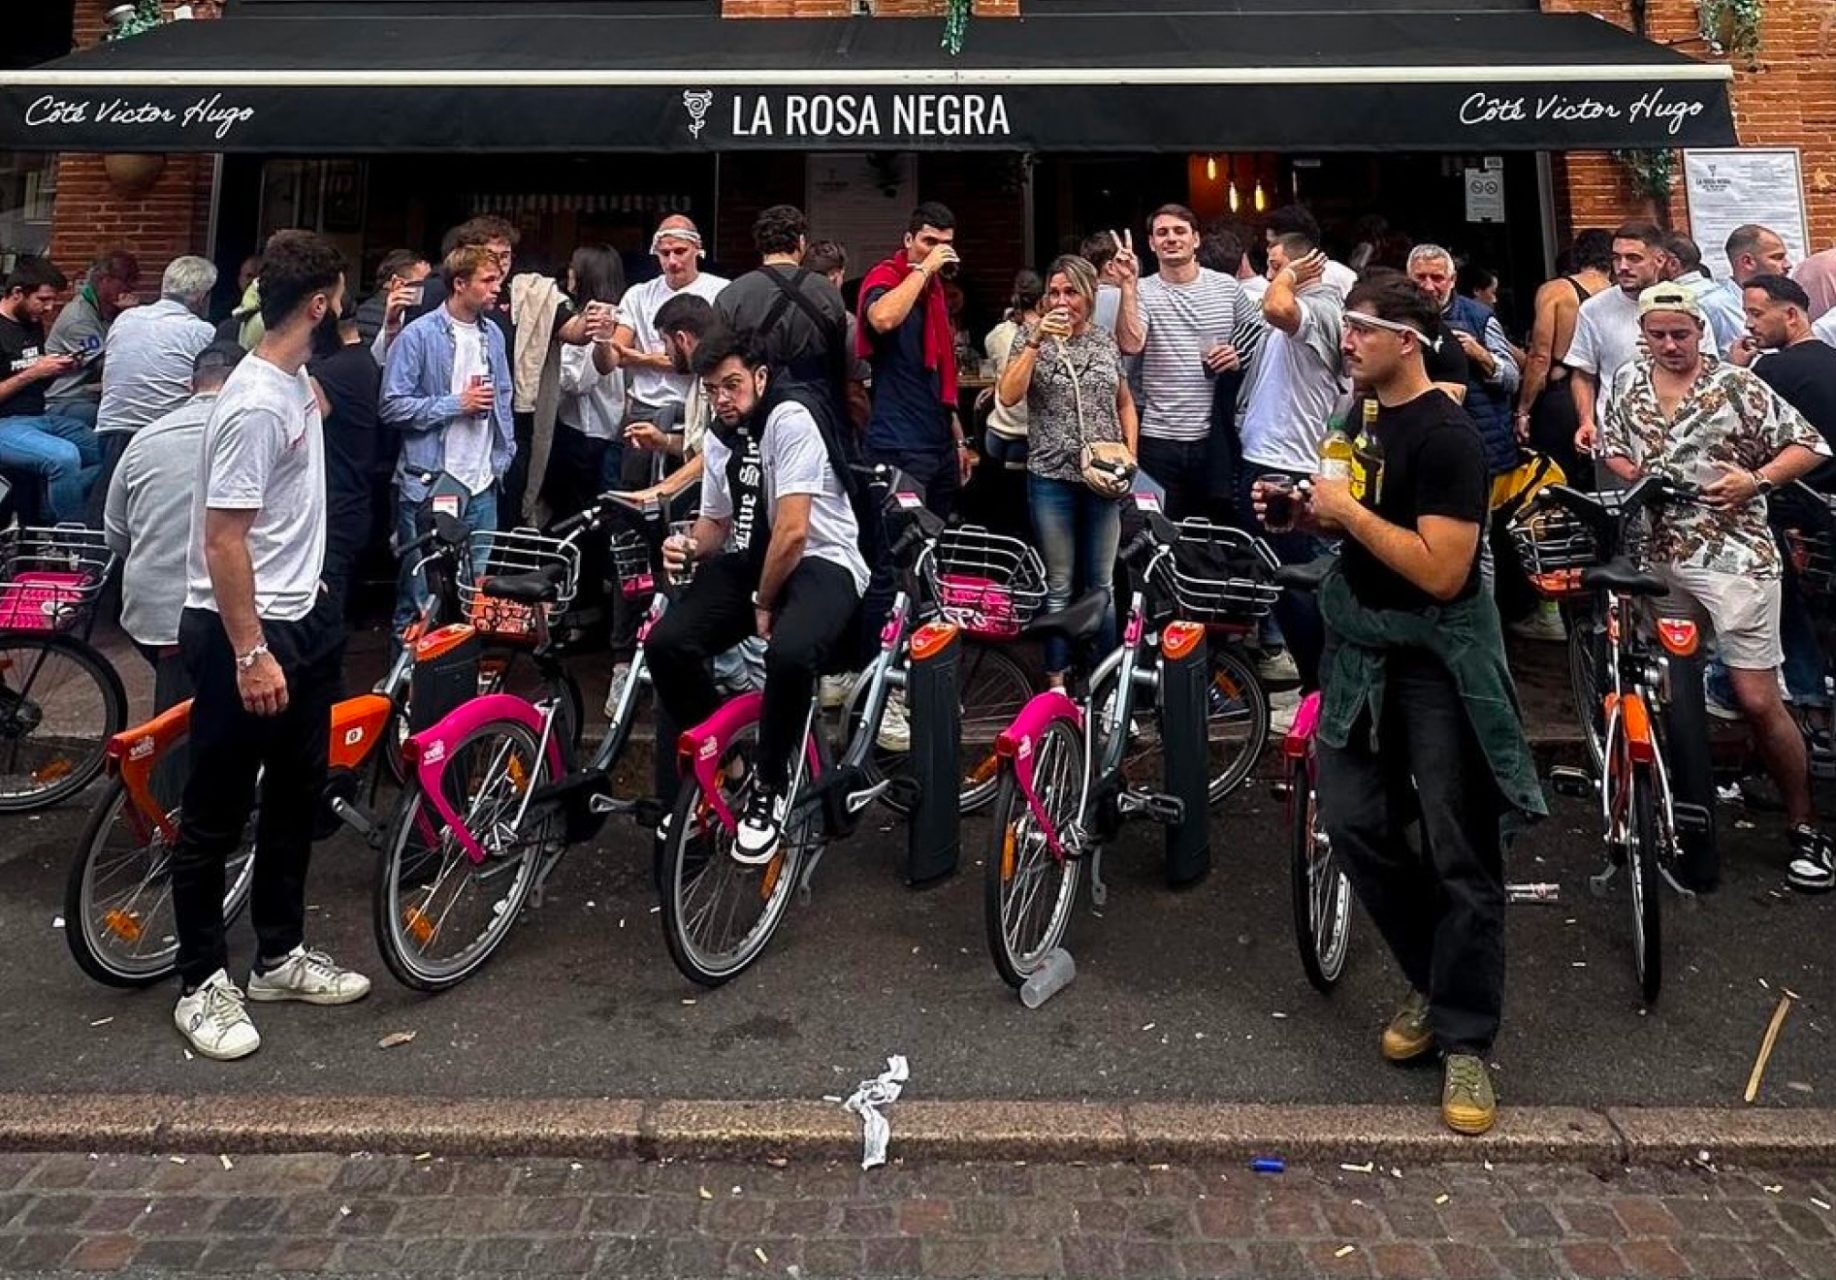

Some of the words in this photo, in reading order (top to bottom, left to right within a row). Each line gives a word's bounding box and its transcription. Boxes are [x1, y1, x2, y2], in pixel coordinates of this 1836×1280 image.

[95, 97, 177, 124] Victor
[181, 92, 255, 139] Hugo
[732, 95, 774, 136] LA
[786, 94, 881, 136] ROSA
[893, 94, 1011, 135] NEGRA
[1534, 94, 1622, 121] Victor
[1629, 87, 1704, 135] Hugo
